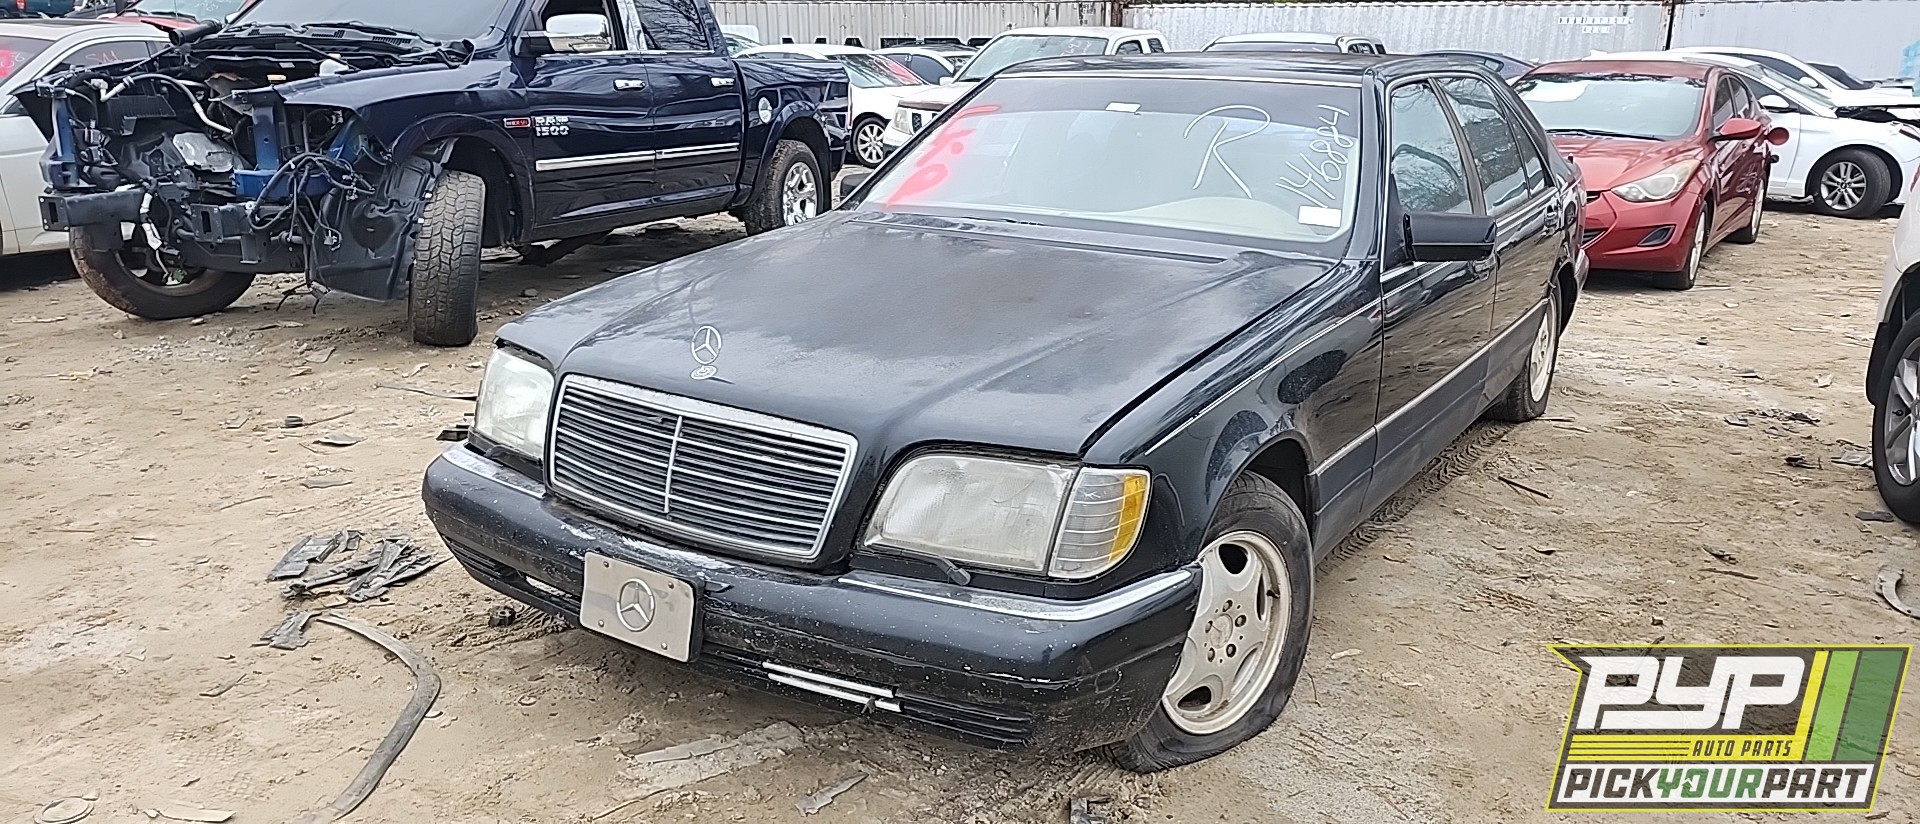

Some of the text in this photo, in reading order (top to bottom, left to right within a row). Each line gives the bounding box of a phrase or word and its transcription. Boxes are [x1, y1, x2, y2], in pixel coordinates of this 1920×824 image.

[535, 125, 570, 137] 1500
[1183, 103, 1271, 199] R
[1274, 104, 1354, 208] 146884
